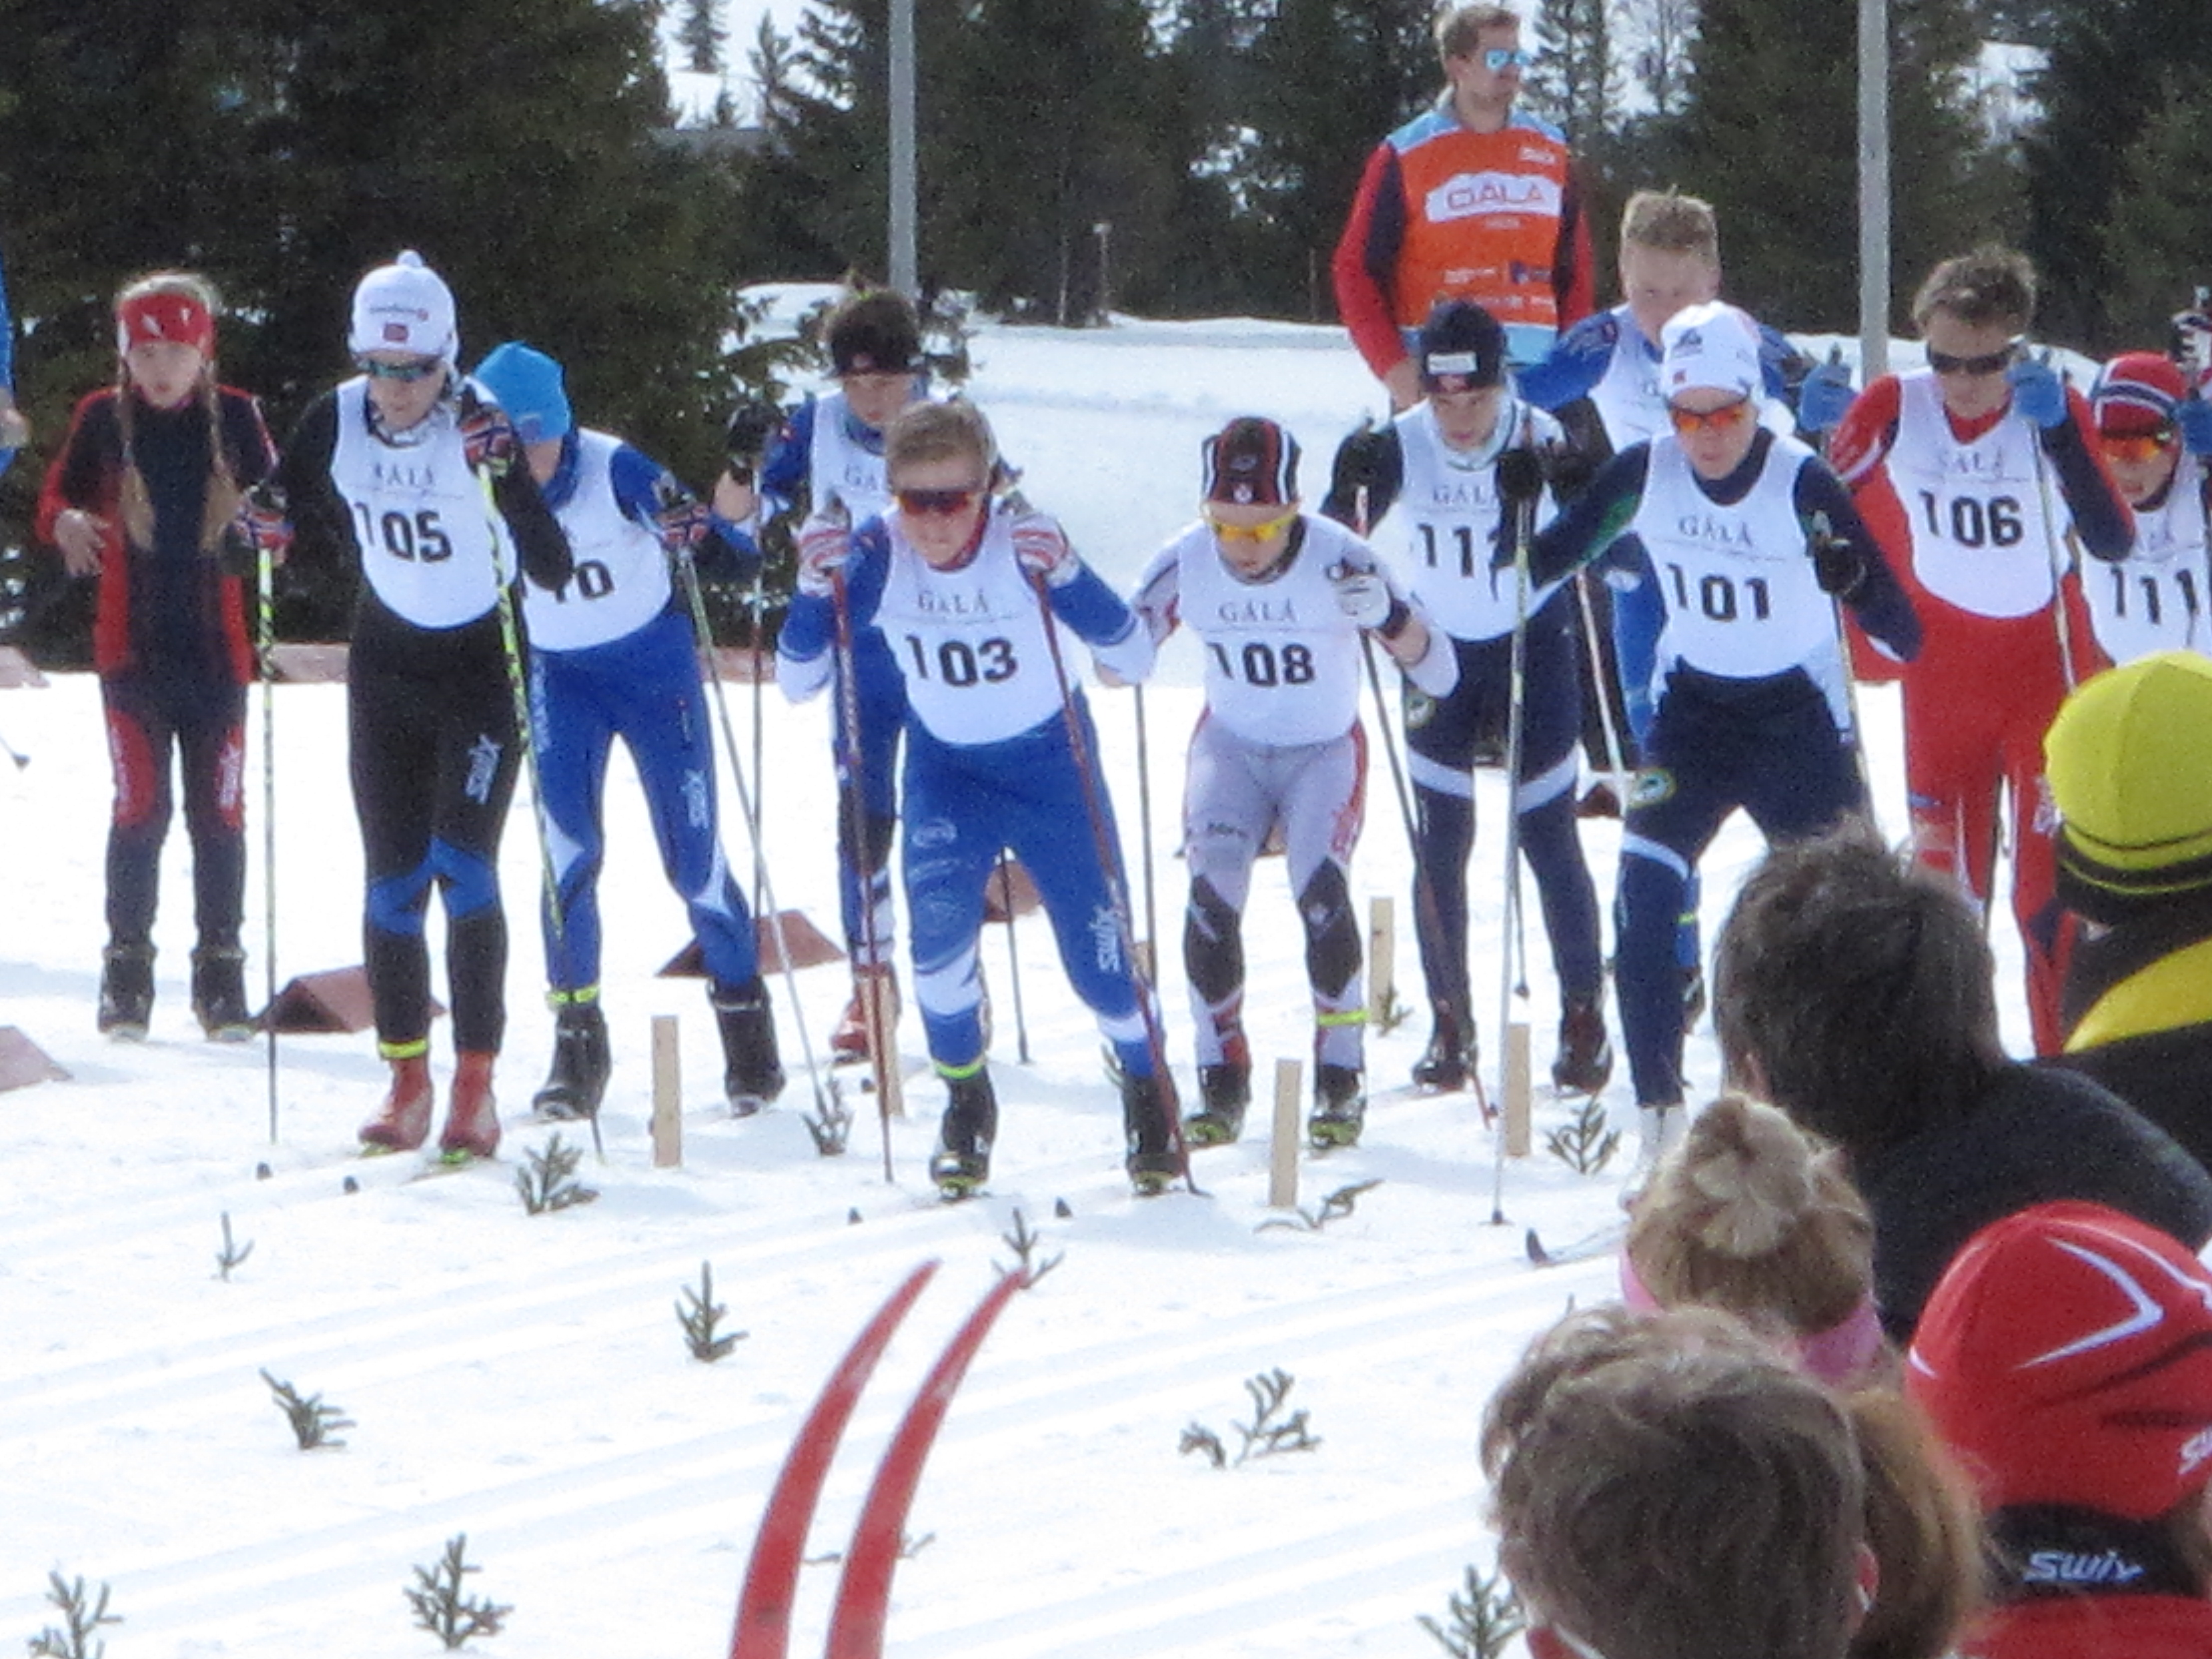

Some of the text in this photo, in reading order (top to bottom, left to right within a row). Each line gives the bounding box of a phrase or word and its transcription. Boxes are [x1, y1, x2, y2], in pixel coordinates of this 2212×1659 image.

[354, 501, 453, 564] 105
[1919, 489, 2024, 548] 106
[1417, 523, 1499, 578] 11
[1666, 562, 1770, 623] 101
[2110, 563, 2199, 625] 111
[905, 634, 1019, 687] 103
[1205, 642, 1316, 687] 108
